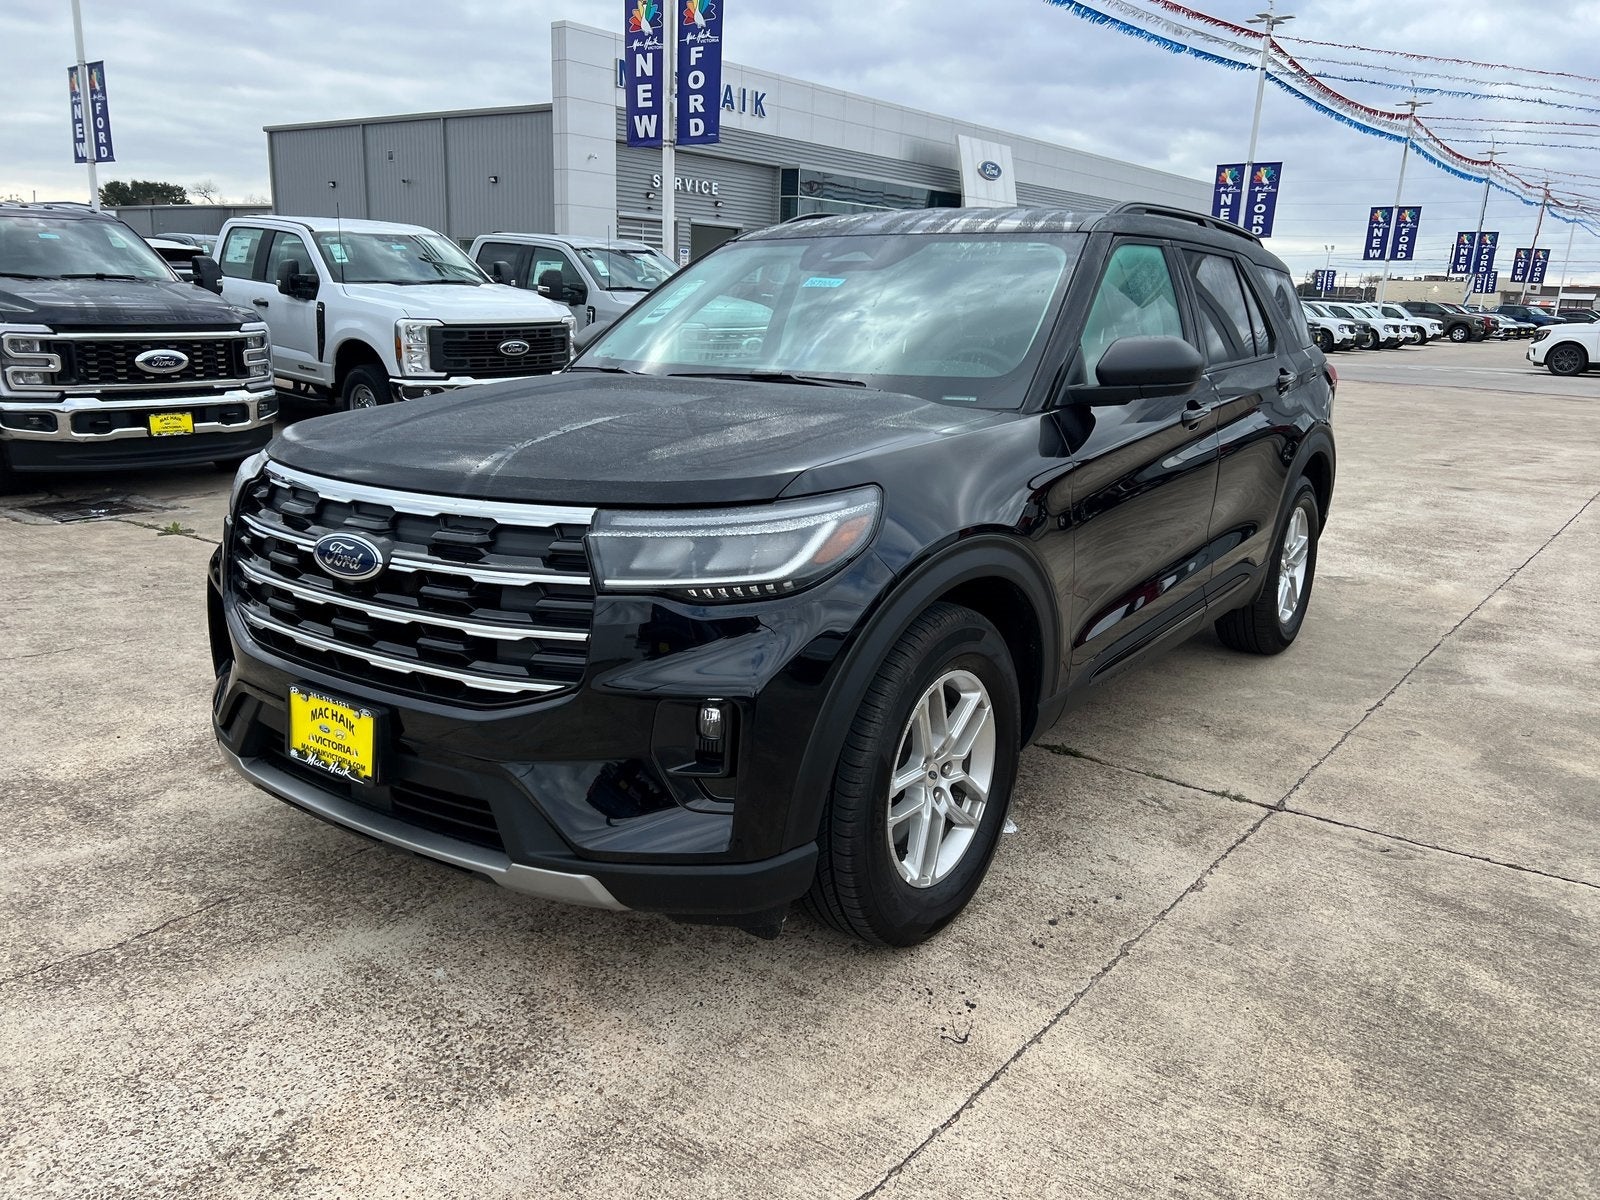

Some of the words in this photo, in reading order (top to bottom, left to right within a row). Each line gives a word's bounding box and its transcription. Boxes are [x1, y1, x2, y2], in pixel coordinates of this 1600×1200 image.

[634, 53, 658, 139] NEW
[688, 46, 706, 136] FORD
[721, 83, 767, 118] AIK
[74, 104, 87, 158] NEW
[95, 103, 108, 158] FORD
[653, 174, 719, 195] SRVICE
[1220, 194, 1233, 220] NE
[1252, 193, 1267, 235] FORD
[1369, 228, 1383, 258] NEW
[1396, 228, 1410, 259] FORD
[1457, 248, 1468, 272] NEW
[1479, 248, 1490, 272] FORD
[1514, 261, 1525, 281] NEW
[1532, 261, 1543, 282] FORD
[152, 355, 177, 367] Ford
[325, 541, 364, 570] Ford
[310, 707, 330, 722] MAC
[331, 709, 356, 736] HAIK
[305, 752, 328, 767] Mac
[314, 734, 352, 756] VICTORIA
